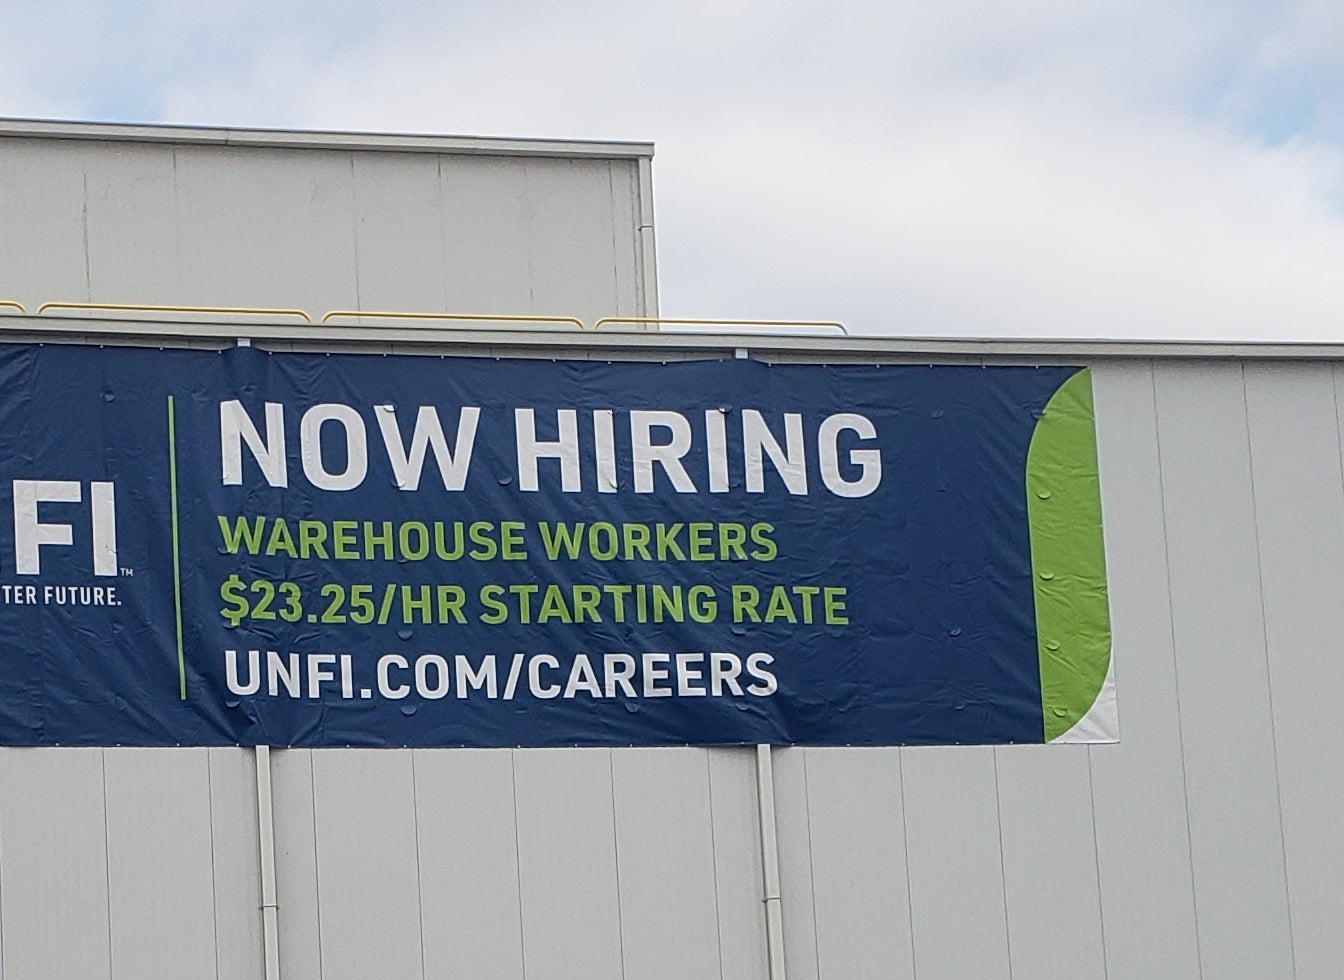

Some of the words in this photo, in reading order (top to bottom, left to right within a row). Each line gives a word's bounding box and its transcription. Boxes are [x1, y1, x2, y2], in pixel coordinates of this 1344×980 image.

[220, 399, 481, 491] NOW
[515, 407, 882, 498] HIRING
[219, 517, 526, 561] WAREHOUSE
[540, 522, 778, 562] WORKERS
[44, 585, 123, 606] FUTURE.
[221, 575, 466, 626] $23.25/HR
[480, 585, 717, 624] STARTING
[732, 586, 848, 625] RATE
[224, 650, 778, 700] UNFI.COM/CAREERS
